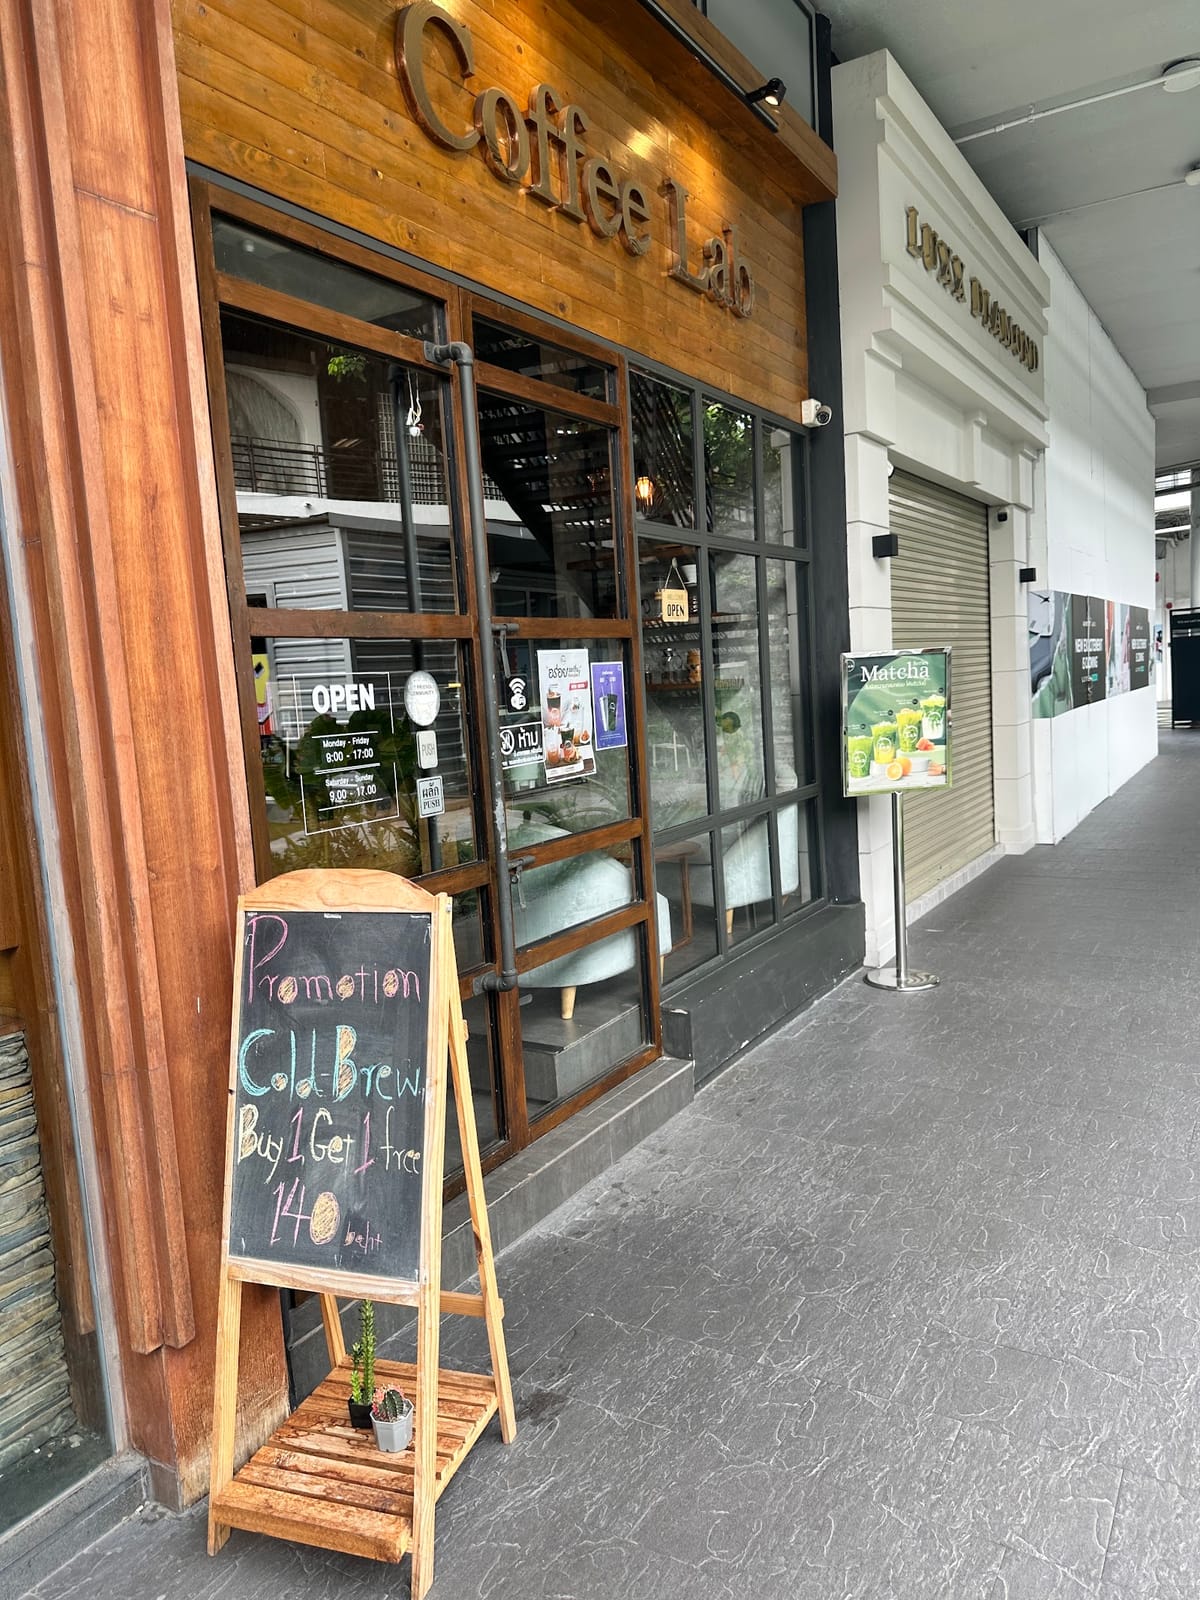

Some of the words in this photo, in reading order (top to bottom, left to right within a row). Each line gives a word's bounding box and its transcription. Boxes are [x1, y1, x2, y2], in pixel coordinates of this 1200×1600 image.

[395, 2, 652, 257] Coffee
[660, 177, 755, 319] Lab
[667, 603, 685, 616] OPEN
[860, 661, 930, 682] Matcha
[312, 683, 376, 714] OPEN
[322, 738, 346, 749] Monday
[352, 736, 370, 745] Friday
[518, 726, 539, 748] ห้าม
[325, 751, 344, 763] 8:00
[353, 748, 374, 760] 17:00
[325, 777, 349, 787] Saturday
[354, 774, 374, 783] Sunday
[422, 782, 440, 798] ผลัก
[423, 800, 441, 810] PUSH
[247, 914, 421, 1004] Promotion
[237, 1103, 283, 1184] Buy
[287, 1107, 304, 1165] 1
[310, 1107, 355, 1170] Get
[354, 1111, 377, 1174] 1
[380, 1105, 421, 1174] free
[270, 1177, 340, 1247] 140
